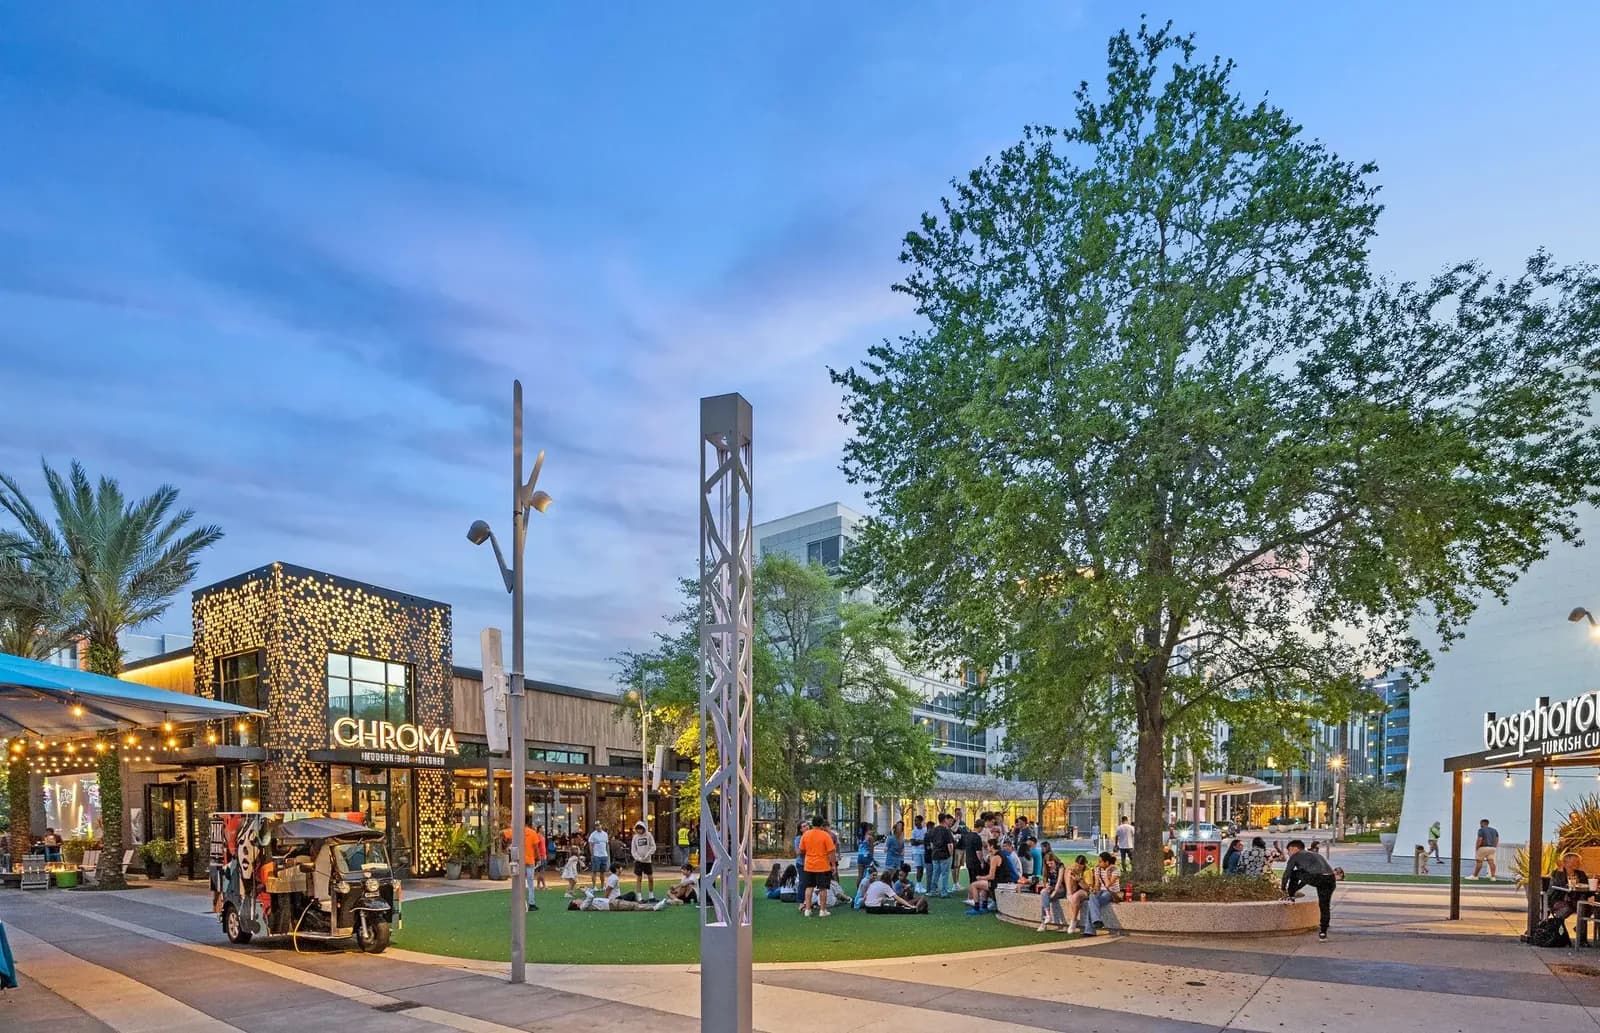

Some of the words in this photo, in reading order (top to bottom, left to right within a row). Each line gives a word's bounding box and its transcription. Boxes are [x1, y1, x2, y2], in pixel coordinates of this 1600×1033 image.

[333, 717, 459, 754] CHROMA
[1483, 691, 1600, 757] bosphoro
[1541, 735, 1582, 755] TURKISH
